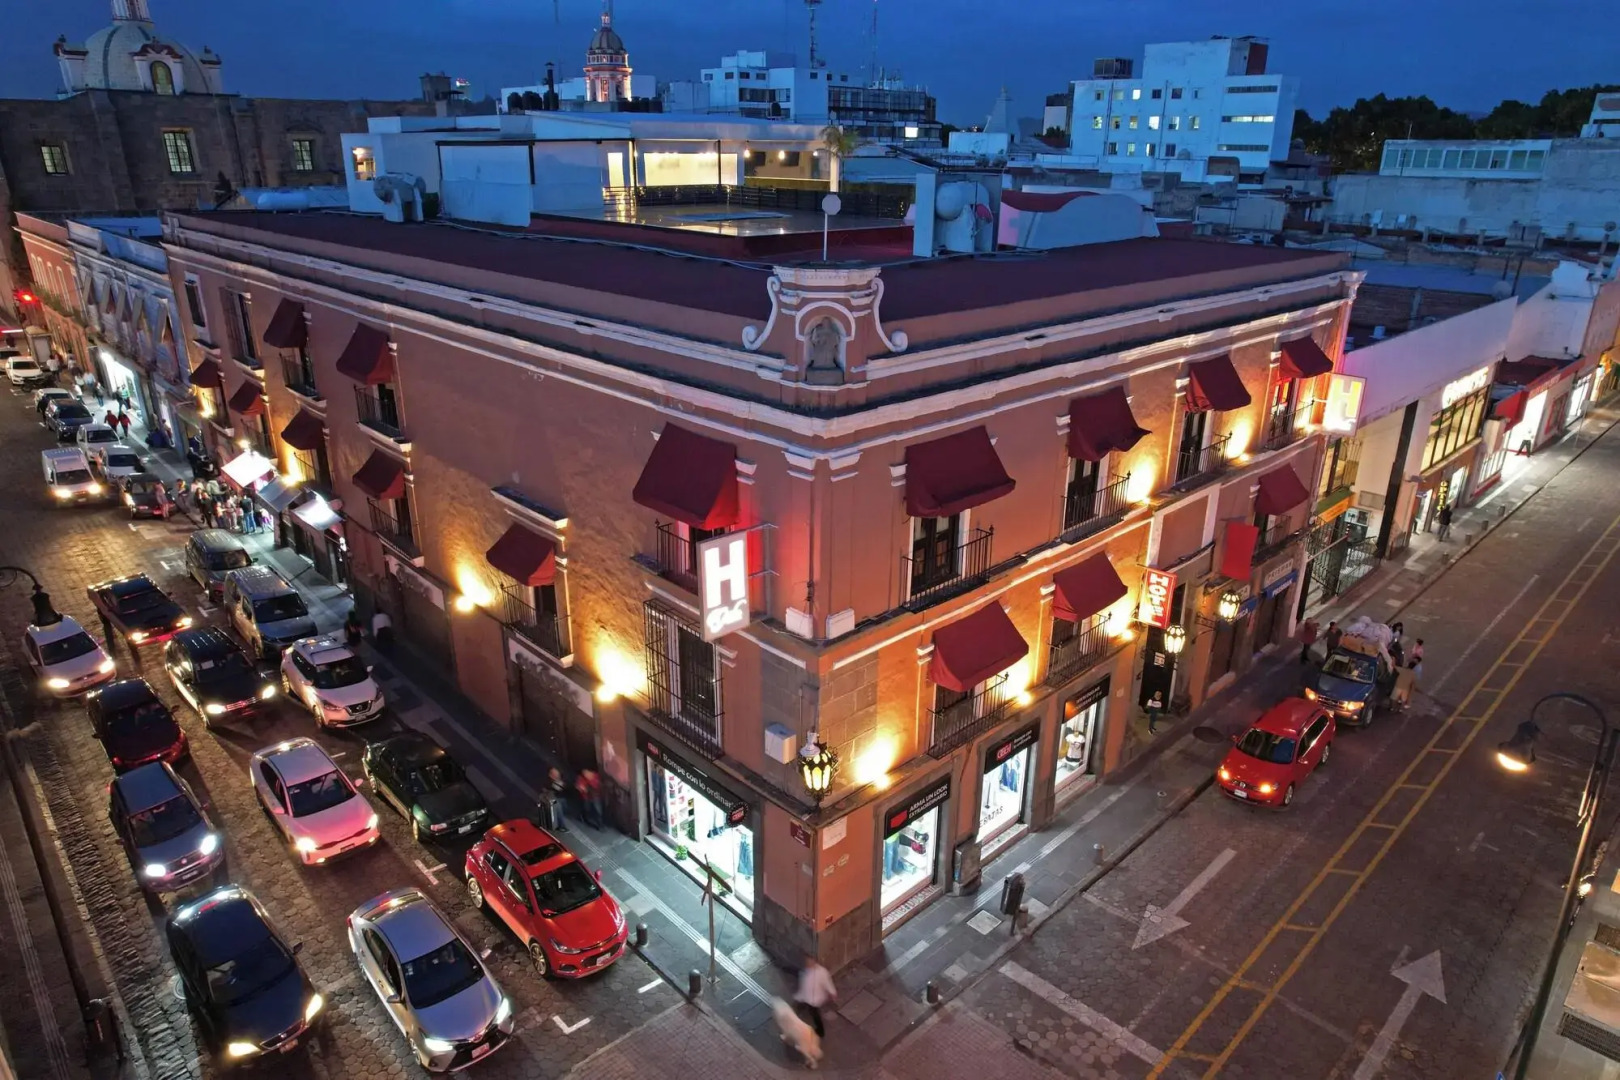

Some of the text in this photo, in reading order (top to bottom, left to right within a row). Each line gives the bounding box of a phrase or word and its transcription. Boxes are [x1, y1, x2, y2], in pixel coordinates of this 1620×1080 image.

[705, 540, 745, 608] H
[1149, 573, 1169, 626] HOTEL
[663, 753, 686, 776] Rompe
[686, 771, 699, 785] con
[699, 779, 706, 791] lo
[908, 790, 948, 819] EXTRAORDINARIO
[909, 783, 948, 812] ARMA UN LOOK
